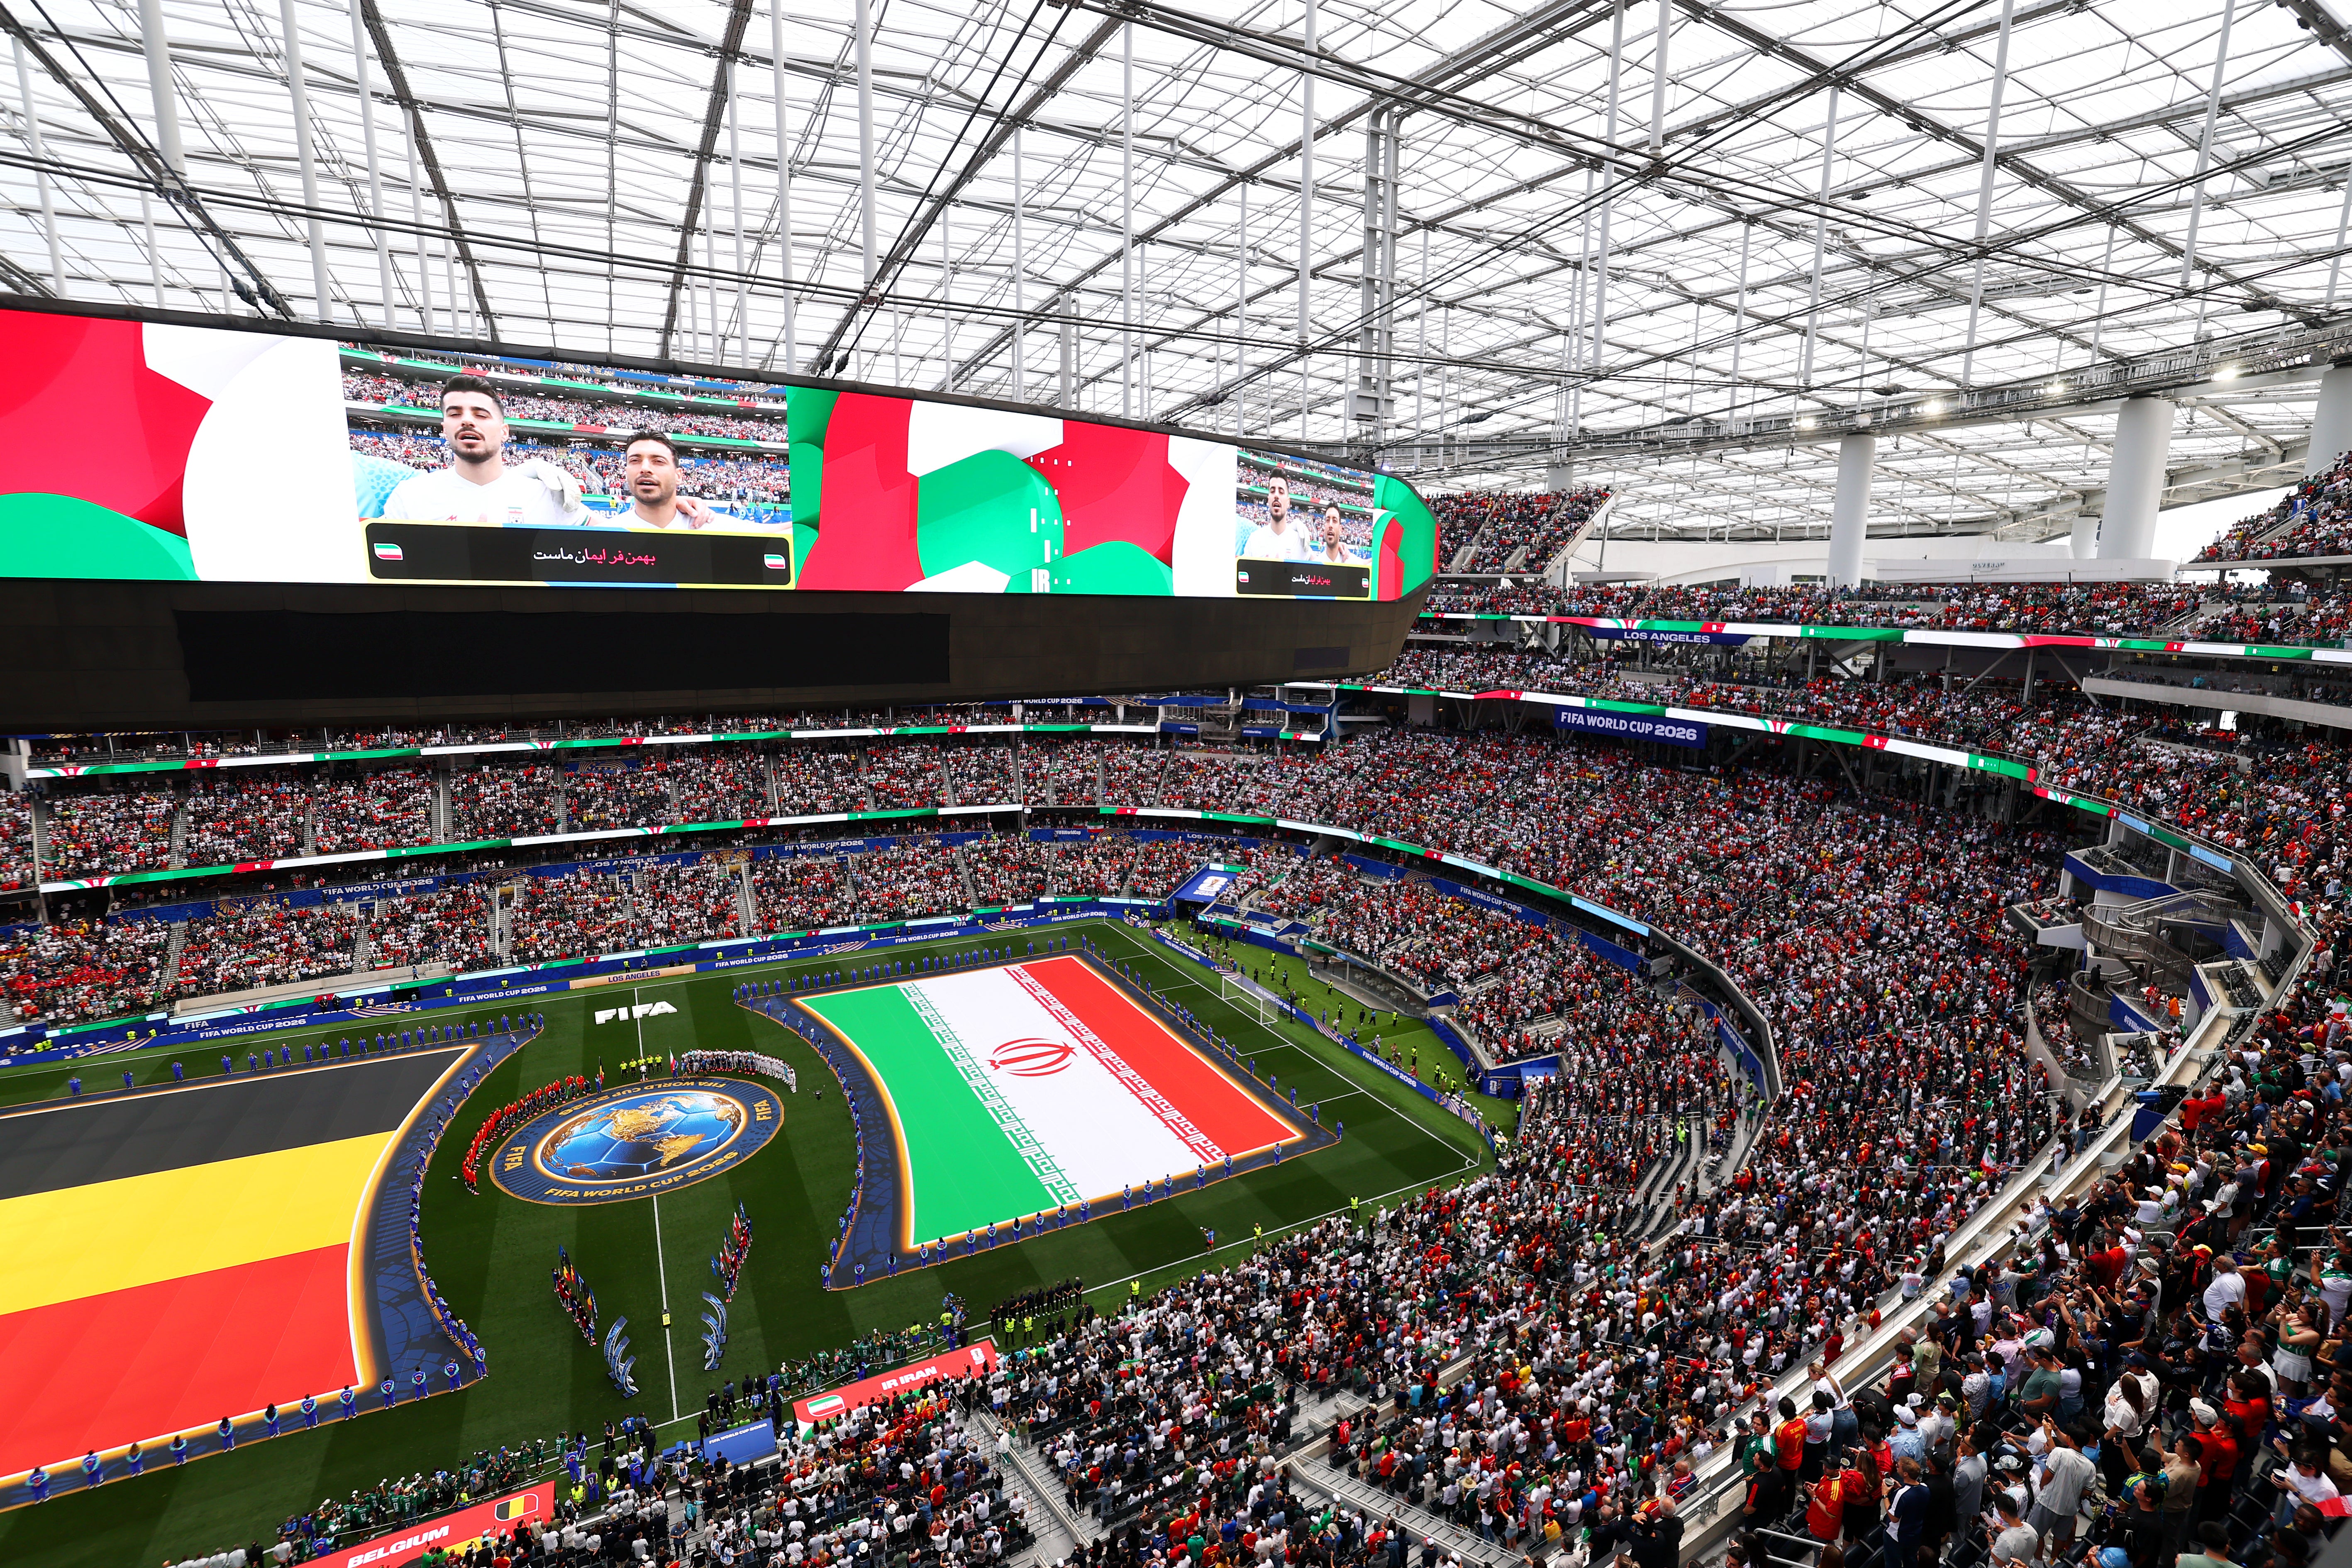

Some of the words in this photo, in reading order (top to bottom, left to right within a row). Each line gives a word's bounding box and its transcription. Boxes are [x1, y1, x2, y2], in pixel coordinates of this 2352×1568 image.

[533, 547, 573, 560] ماست
[574, 548, 606, 564] ایمان
[1624, 632, 1648, 640] LOS
[1650, 633, 1710, 644] ANGELES
[1561, 712, 1585, 725] FIFA
[1586, 715, 1628, 731] WORLD
[1629, 721, 1653, 734] CUP
[1654, 724, 1697, 741] 2026
[345, 884, 379, 893] WORLD
[1460, 887, 1472, 895] FIFA
[1471, 890, 1491, 902] WORLD
[1491, 897, 1503, 905] CUP
[1171, 942, 1182, 952] WORLD
[1188, 951, 1200, 961] 2026
[625, 971, 660, 980] ANGELES
[476, 992, 504, 1000] WORLD
[520, 986, 547, 995] 2026
[595, 1001, 677, 1024] FIFA
[184, 1020, 209, 1030] FIFA
[221, 1026, 255, 1036] WORLD
[275, 1019, 306, 1028] 2026
[1723, 1023, 1744, 1053] ANGELES
[1362, 1051, 1373, 1061] FIFA
[1372, 1056, 1389, 1071] WORLD
[1389, 1067, 1400, 1076] CUP
[1399, 1073, 1417, 1088] 2026
[612, 1087, 642, 1097] CUP
[644, 1081, 695, 1090] WORLD
[559, 1095, 610, 1116] 2026
[753, 1099, 772, 1121] FIFA
[504, 1146, 527, 1172] FIFA
[544, 1188, 579, 1198] FIFA
[583, 1185, 647, 1198] WORLD
[649, 1175, 685, 1189] CUP
[685, 1151, 739, 1178] 2026
[881, 1378, 899, 1391] IR
[899, 1366, 937, 1385] IRAN
[720, 1431, 739, 1441] WORLD
[749, 1423, 768, 1431] 2026
[1795, 1433, 1802, 1451] 7
[347, 1525, 450, 1568] BELGIUM
